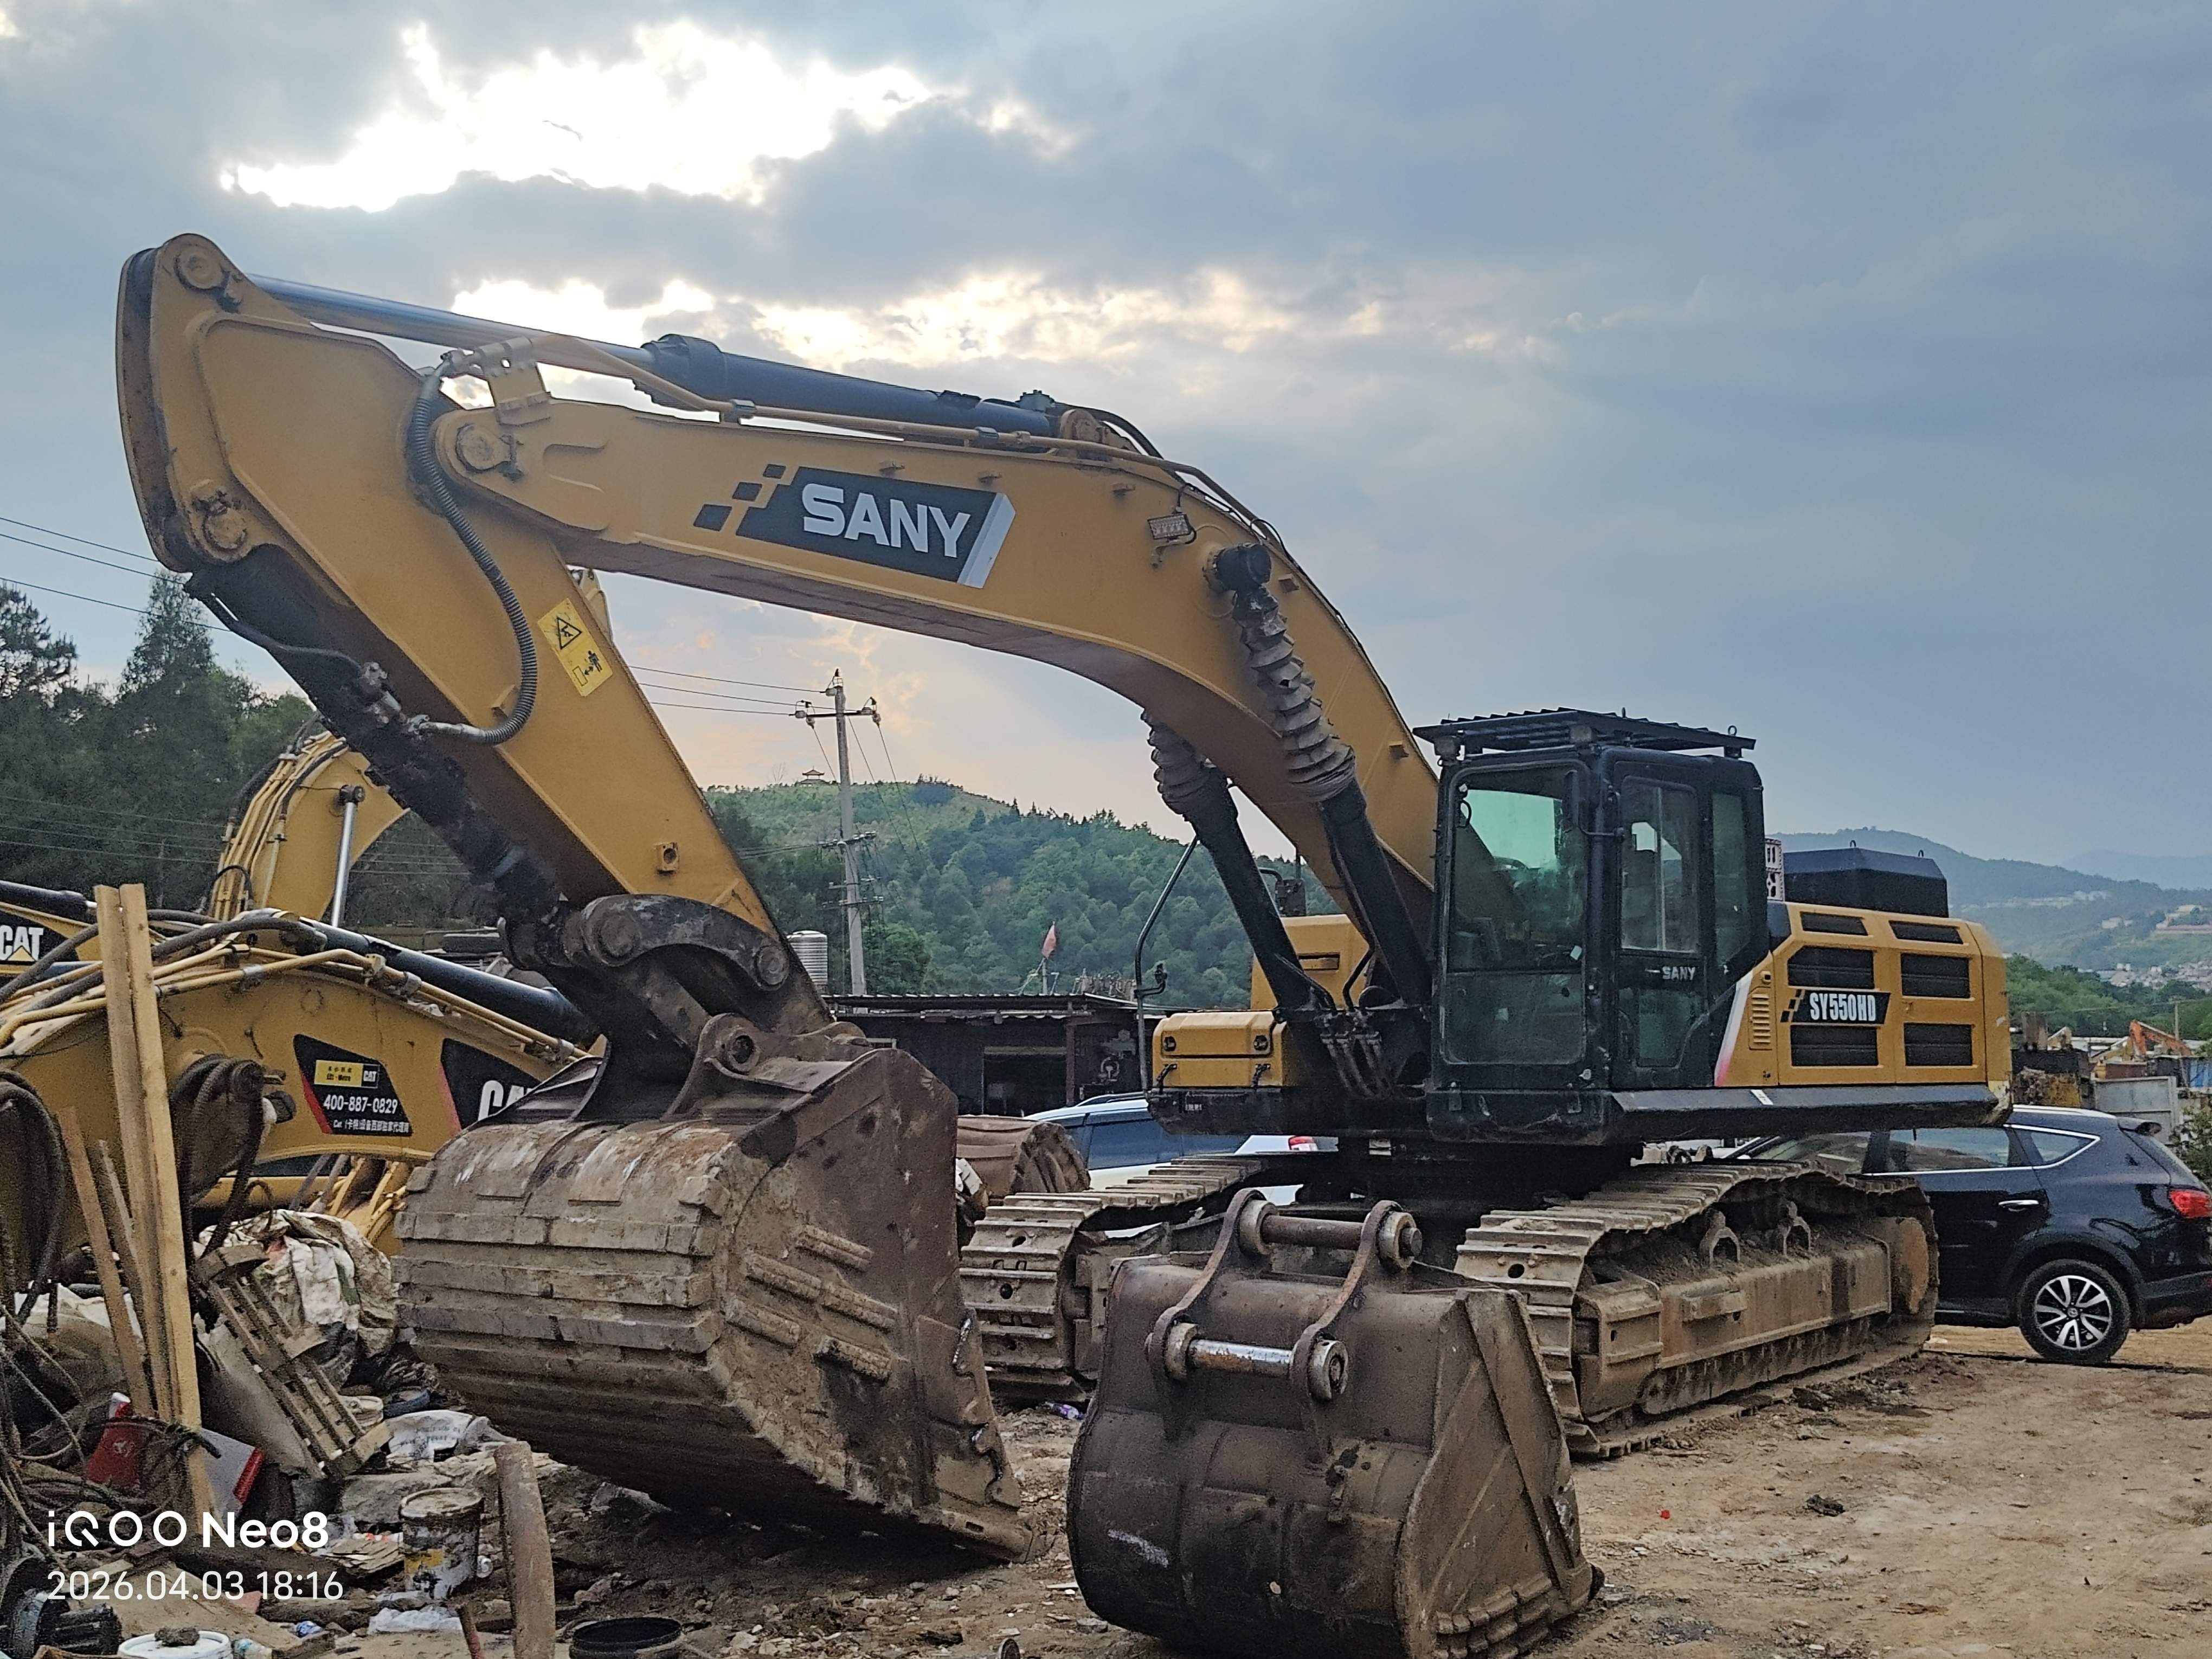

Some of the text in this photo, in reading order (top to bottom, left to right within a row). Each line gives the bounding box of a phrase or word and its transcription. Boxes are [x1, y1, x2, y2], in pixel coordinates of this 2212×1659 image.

[802, 483, 970, 557] SANY
[0, 925, 44, 961] CAT
[1662, 966, 1696, 980] SANY
[1809, 992, 1876, 1021] SY550HD
[363, 1070, 378, 1082] CAT
[323, 1094, 398, 1114] 400-887-0829
